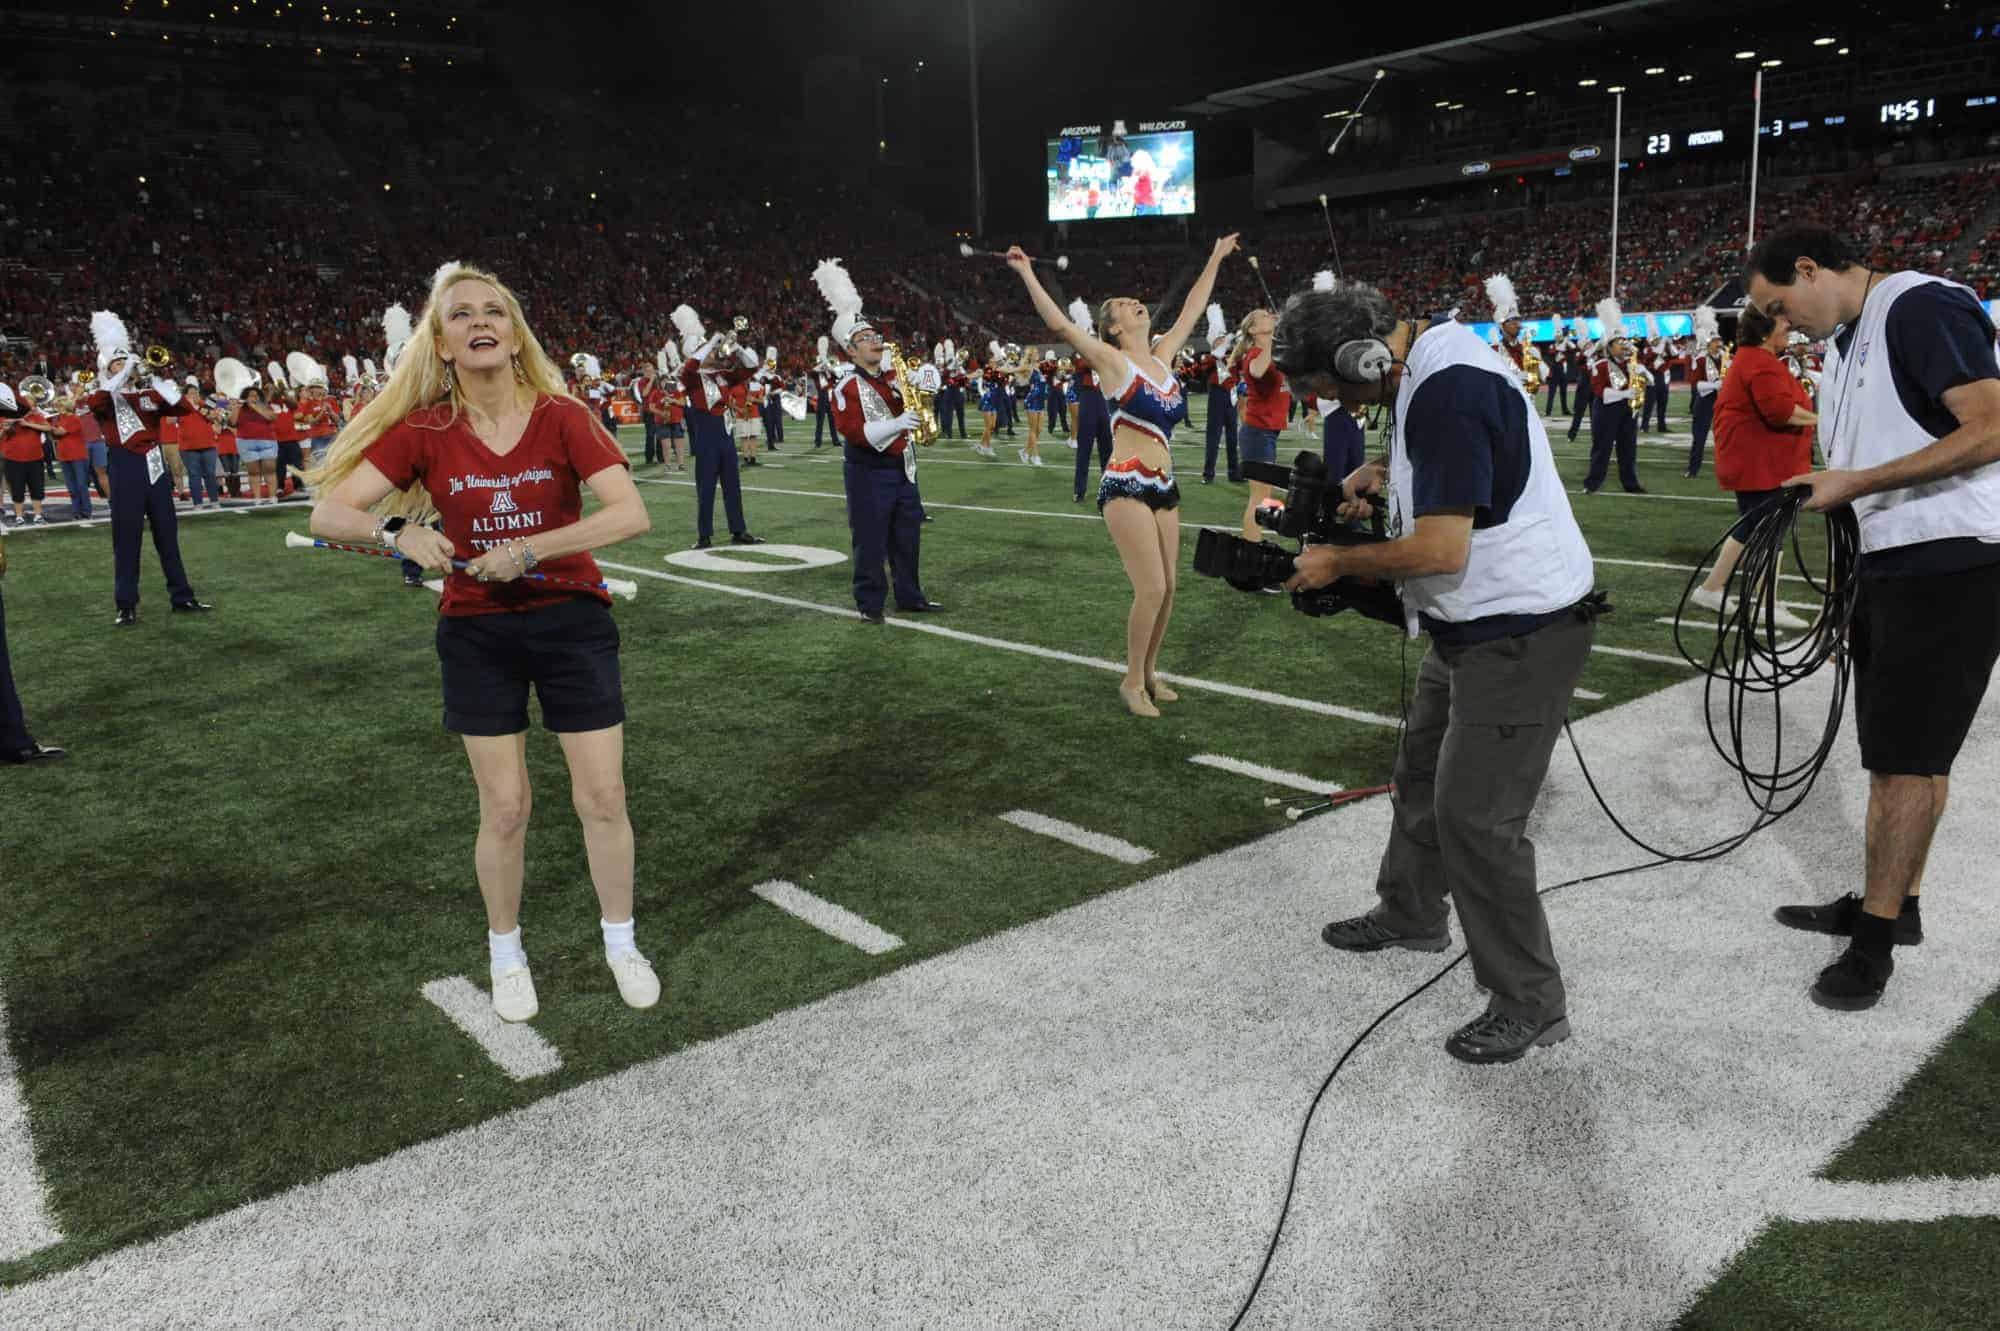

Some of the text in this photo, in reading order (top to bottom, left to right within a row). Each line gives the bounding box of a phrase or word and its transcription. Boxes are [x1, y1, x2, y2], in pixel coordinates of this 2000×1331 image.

[1880, 98, 1935, 123] 14:51
[1060, 125, 1101, 136] ARIZONA
[1139, 120, 1187, 131] WILDCATS
[1772, 119, 1783, 136] 3
[1647, 133, 1671, 154] 23
[449, 477, 464, 496] The
[465, 474, 511, 490] University
[511, 471, 523, 487] of
[489, 490, 518, 513] A
[472, 511, 542, 532] ALUMNI
